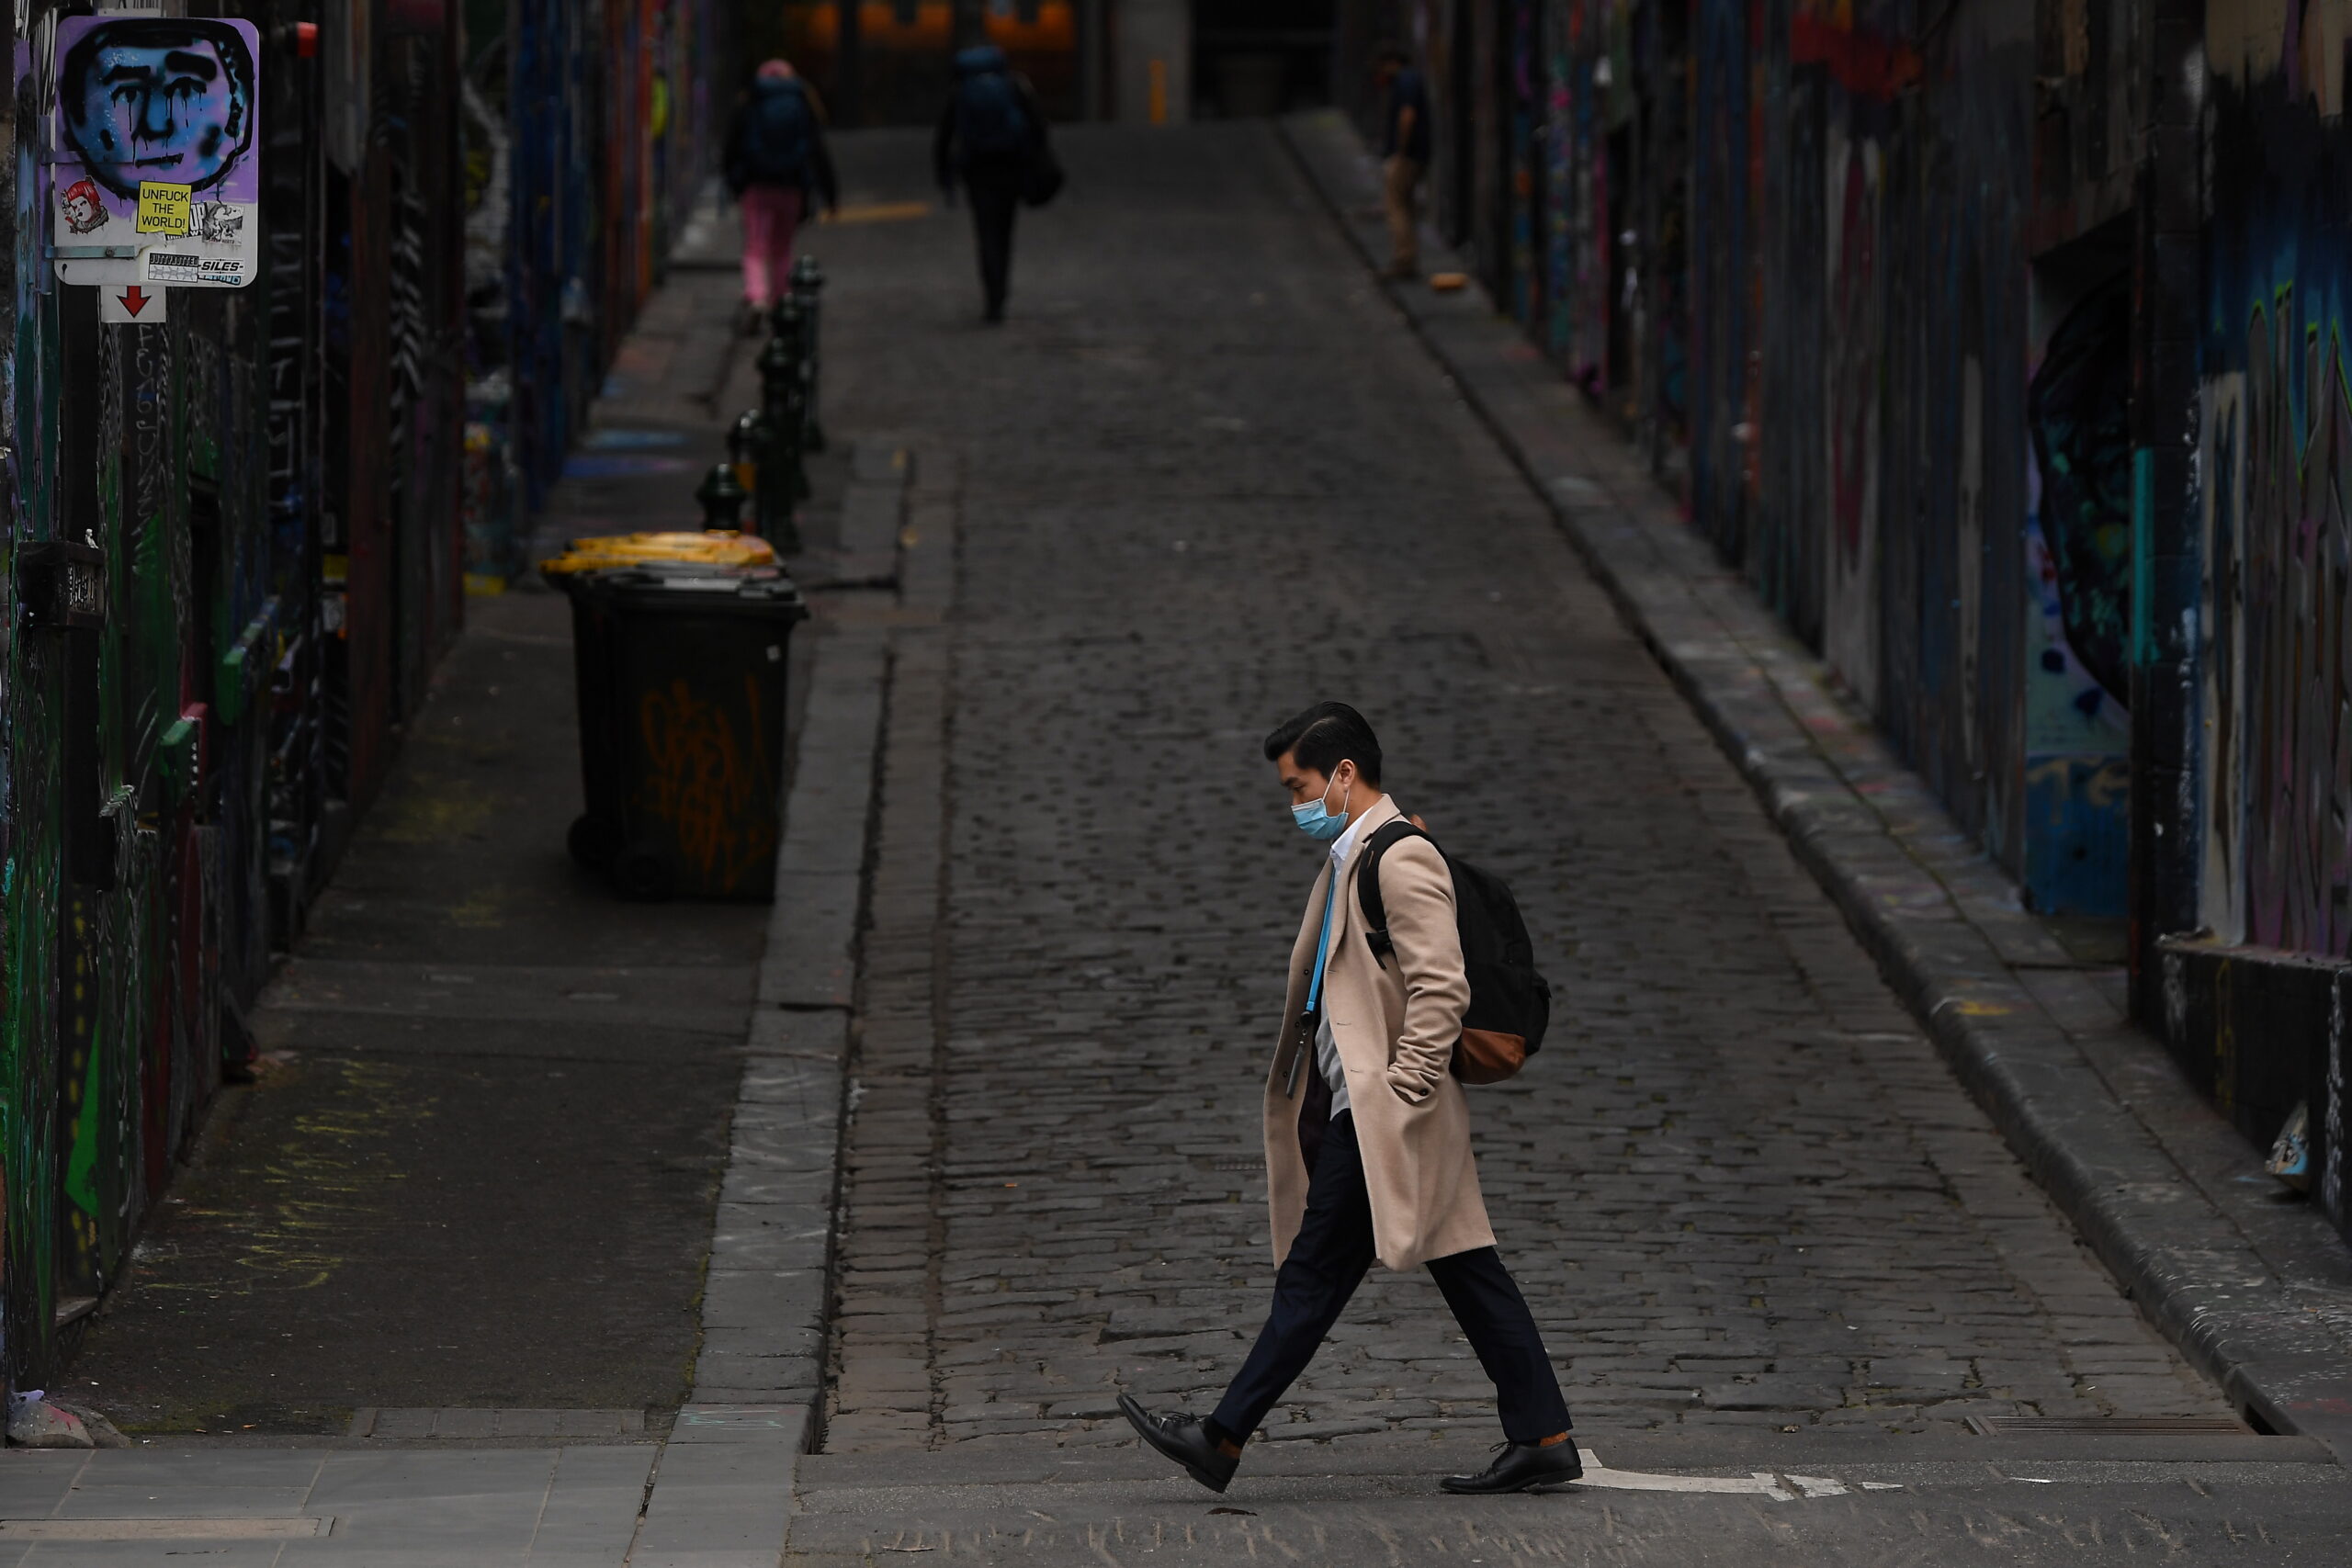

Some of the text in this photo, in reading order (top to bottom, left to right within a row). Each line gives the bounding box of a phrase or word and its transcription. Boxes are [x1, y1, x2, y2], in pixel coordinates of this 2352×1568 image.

[142, 189, 189, 202] UNFUCK
[153, 203, 175, 214] THE
[141, 215, 186, 229] WORLD!
